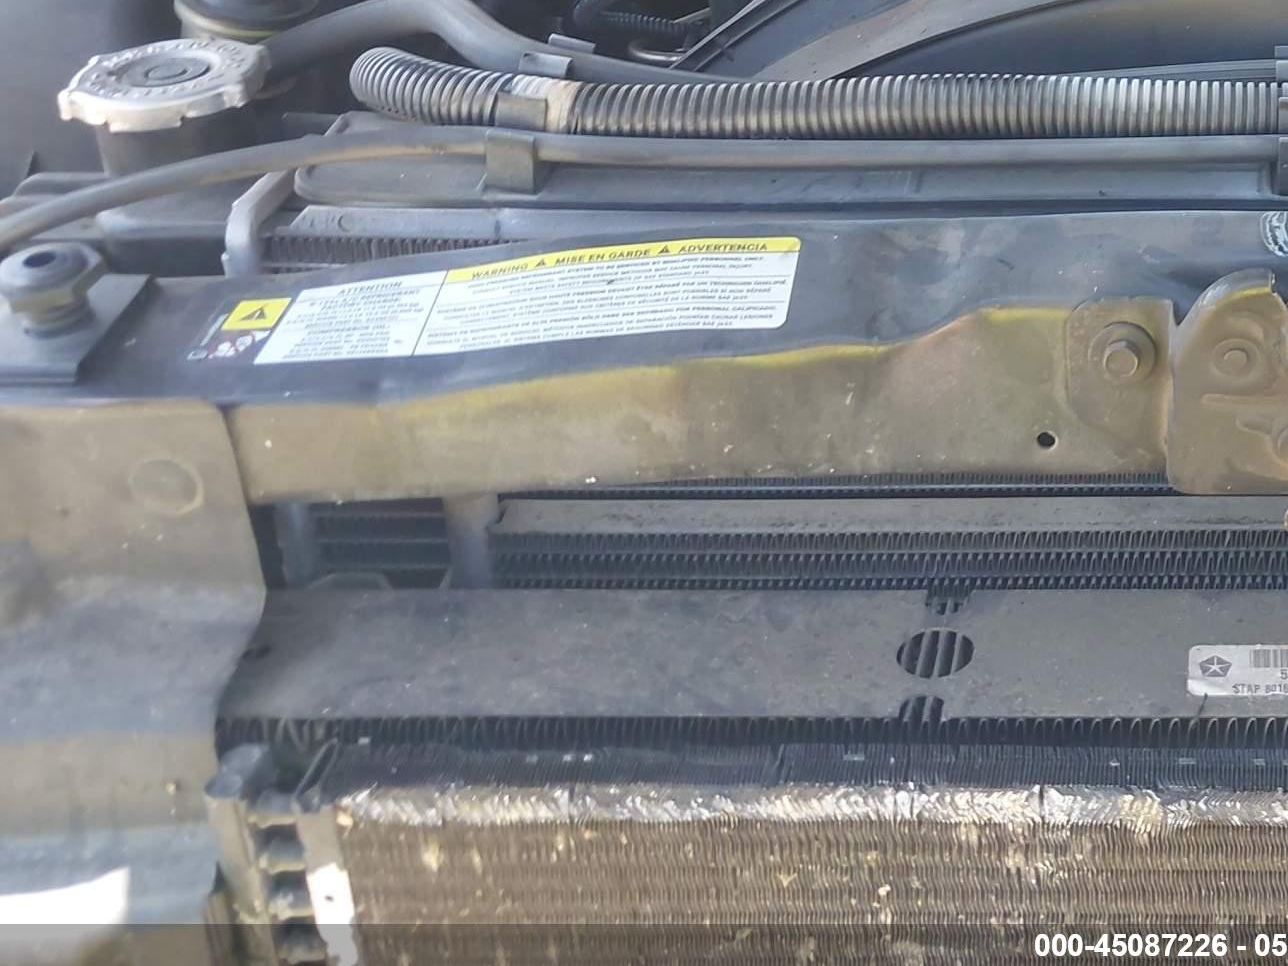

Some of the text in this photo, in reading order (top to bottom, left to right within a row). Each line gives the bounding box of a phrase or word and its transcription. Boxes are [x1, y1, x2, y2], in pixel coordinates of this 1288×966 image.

[472, 242, 768, 280] WARNING MISE EN GARDE ADVERTENCIA
